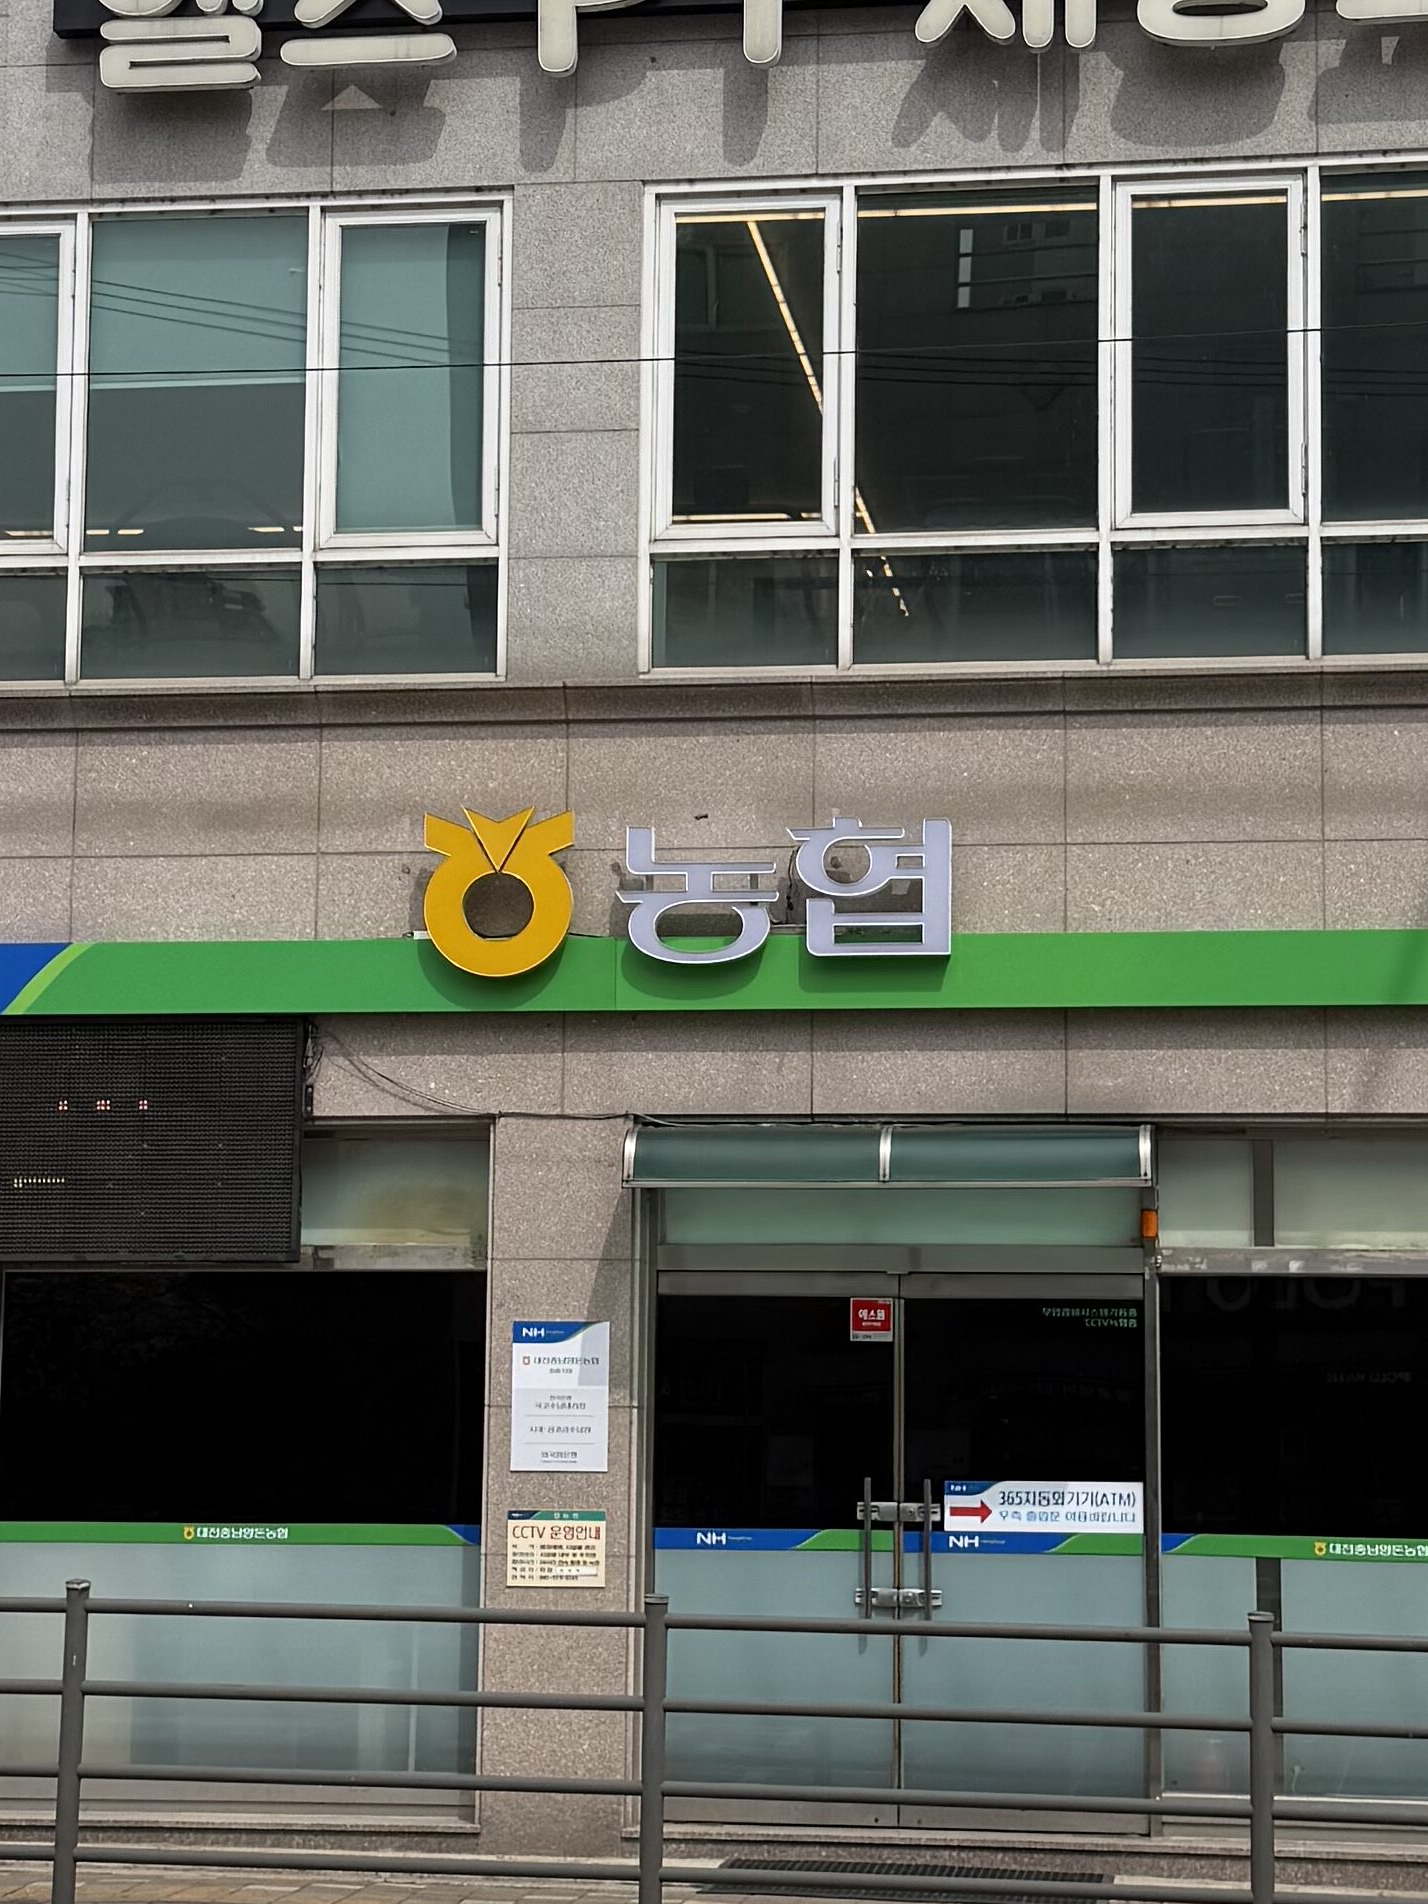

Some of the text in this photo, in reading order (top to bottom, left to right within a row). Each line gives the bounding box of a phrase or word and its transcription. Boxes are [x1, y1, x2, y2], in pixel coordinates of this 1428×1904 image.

[616, 816, 952, 964] 농협
[522, 1327, 545, 1337] NH
[513, 1526, 546, 1539] CCTV
[696, 1532, 726, 1545] NH
[949, 1535, 979, 1548] NH
